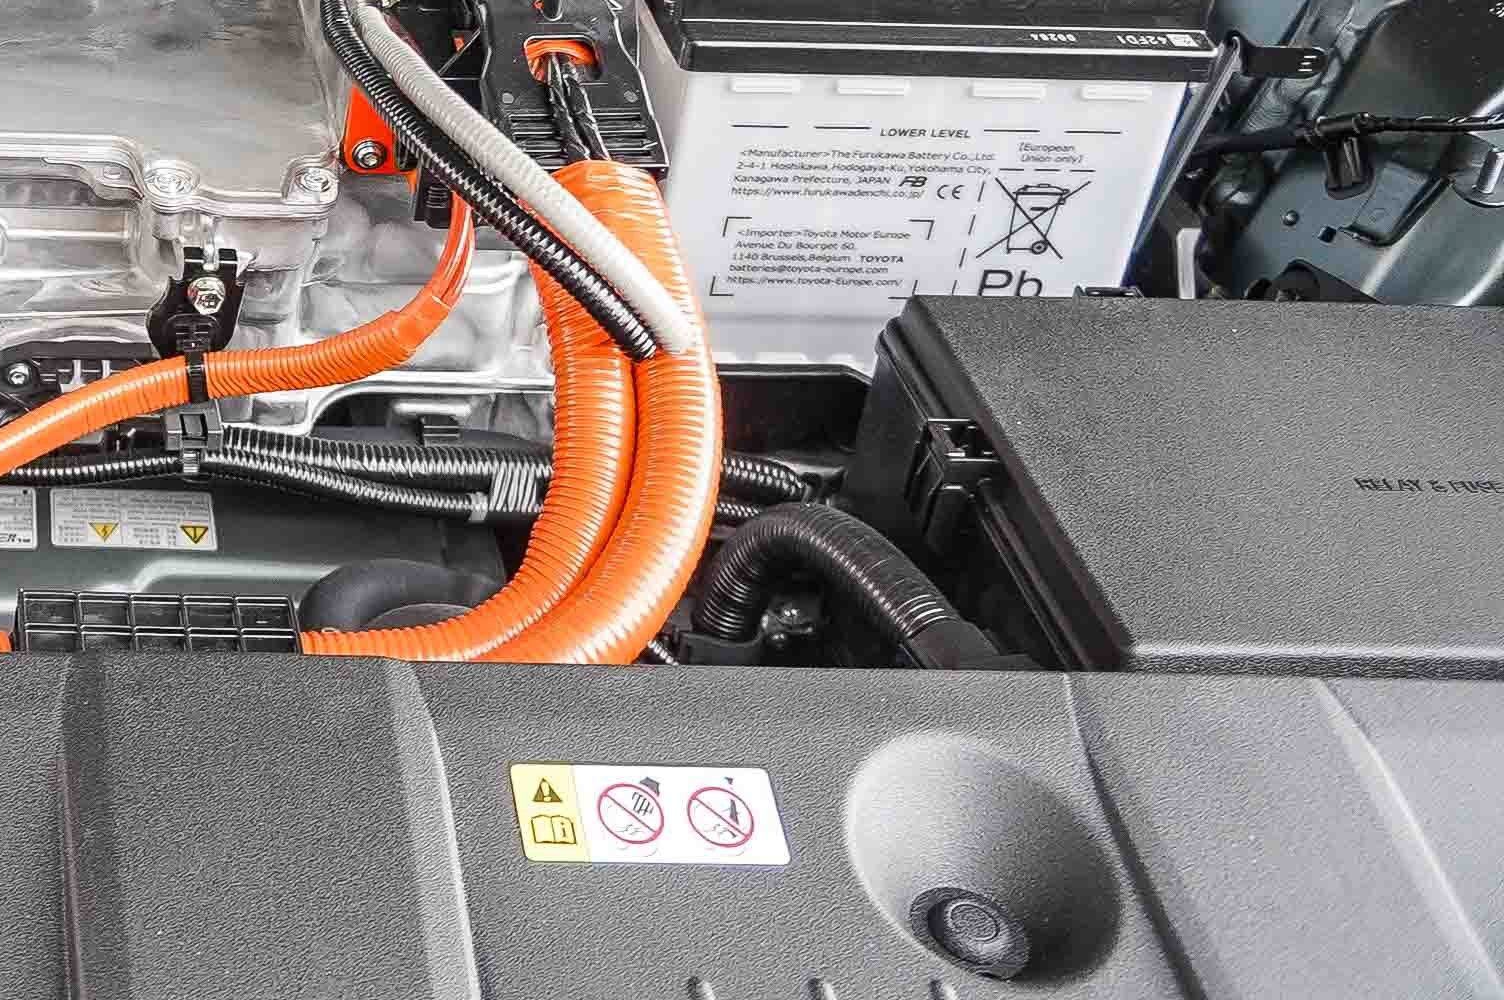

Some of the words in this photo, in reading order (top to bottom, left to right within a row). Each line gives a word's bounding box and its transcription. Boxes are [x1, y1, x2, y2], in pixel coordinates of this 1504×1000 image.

[880, 128, 926, 137] LOWER
[930, 129, 971, 138] LEVEL
[736, 161, 766, 170] 2-4-1
[734, 175, 789, 184] Kanagawa
[856, 177, 891, 185] JAPAN
[839, 229, 872, 239] Motor
[873, 230, 912, 240] Europe
[735, 241, 774, 250] Avenue
[777, 241, 793, 250] Du
[732, 253, 759, 262] 1140
[860, 255, 904, 263] TOYOTA
[977, 269, 1043, 297] Pb
